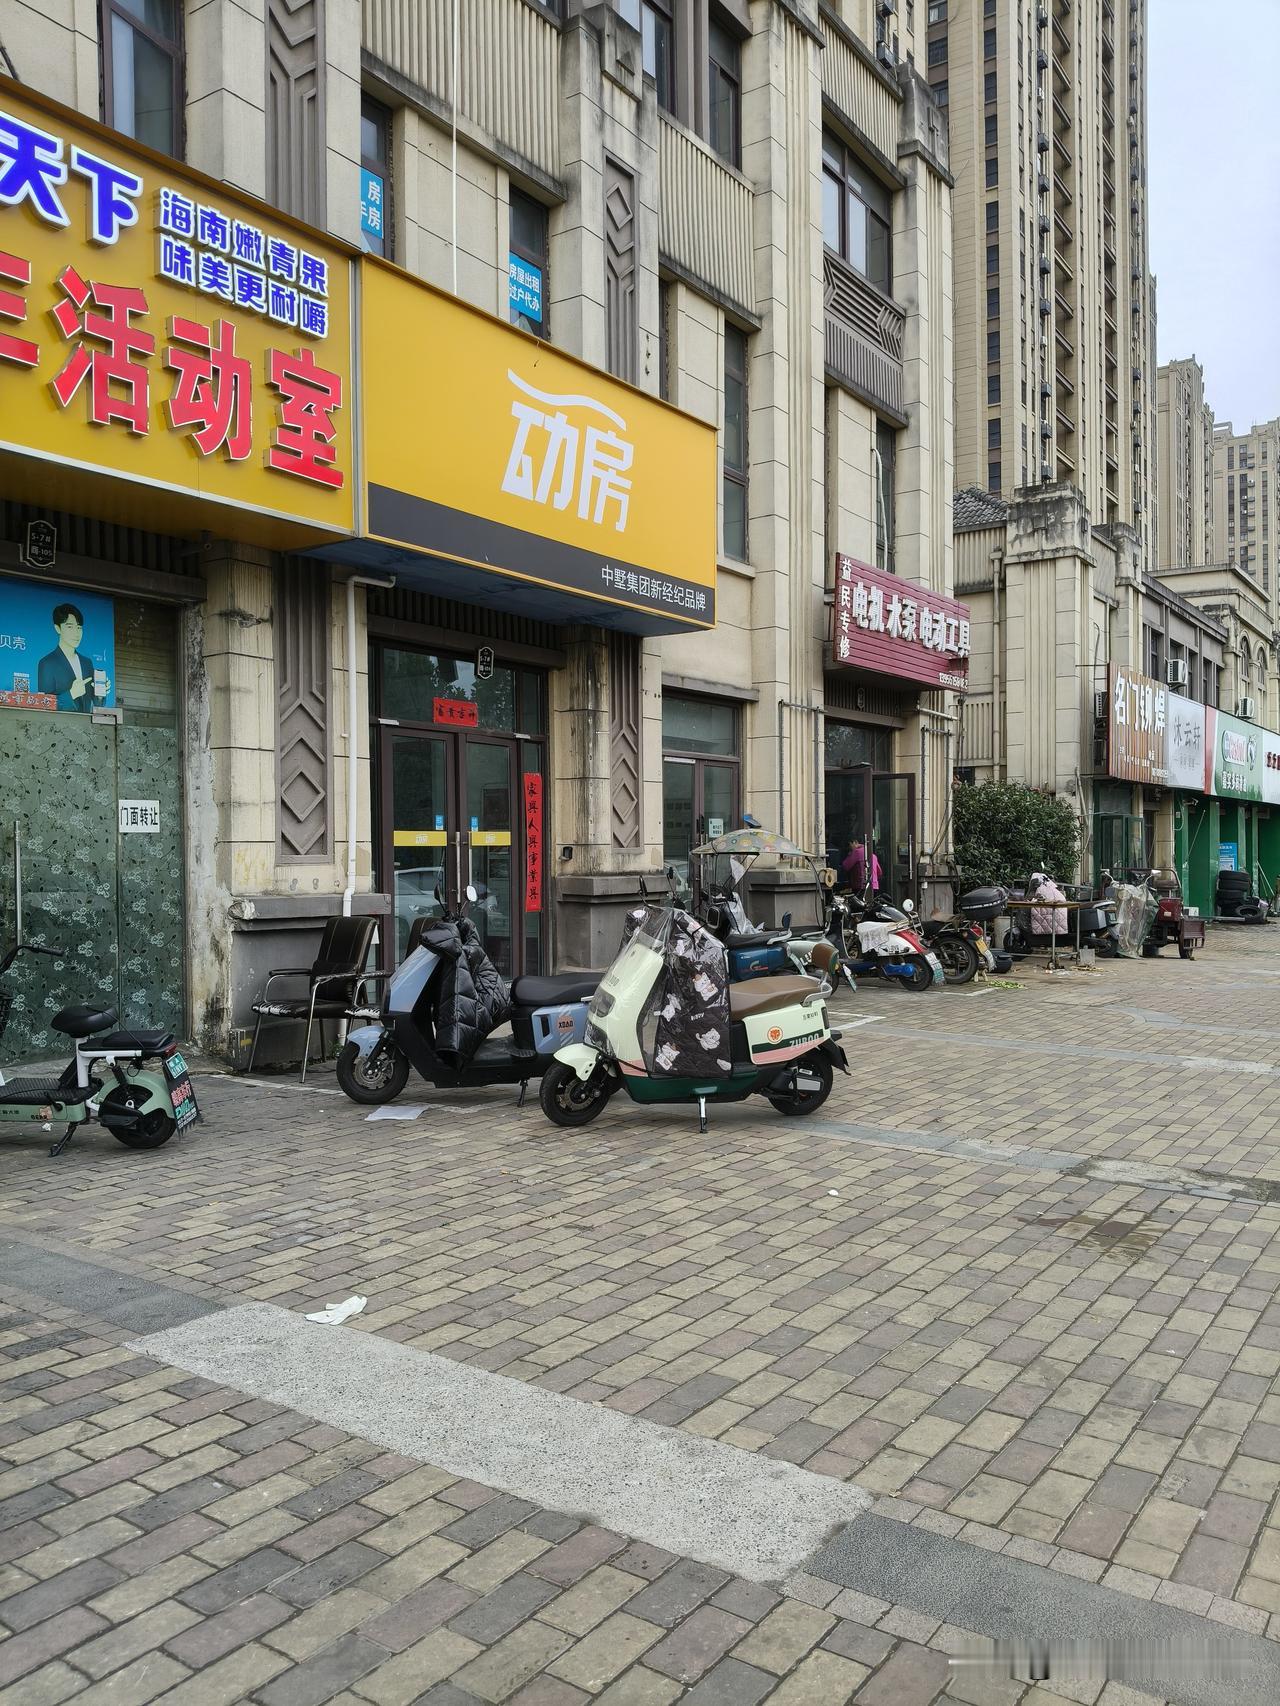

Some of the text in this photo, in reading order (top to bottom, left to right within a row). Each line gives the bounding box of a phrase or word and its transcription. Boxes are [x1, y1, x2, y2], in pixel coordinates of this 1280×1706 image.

[157, 187, 328, 296] 海南嫩青果
[156, 234, 328, 339] 味美更耐嚼
[509, 263, 540, 293] 房屋出租
[509, 283, 540, 312] 过户代办
[601, 564, 706, 612] 中墅集团新经纪品牌
[839, 558, 852, 658] 益民专修
[852, 581, 971, 658] 电机 水泵 电动工具
[120, 806, 158, 826] 门面转让
